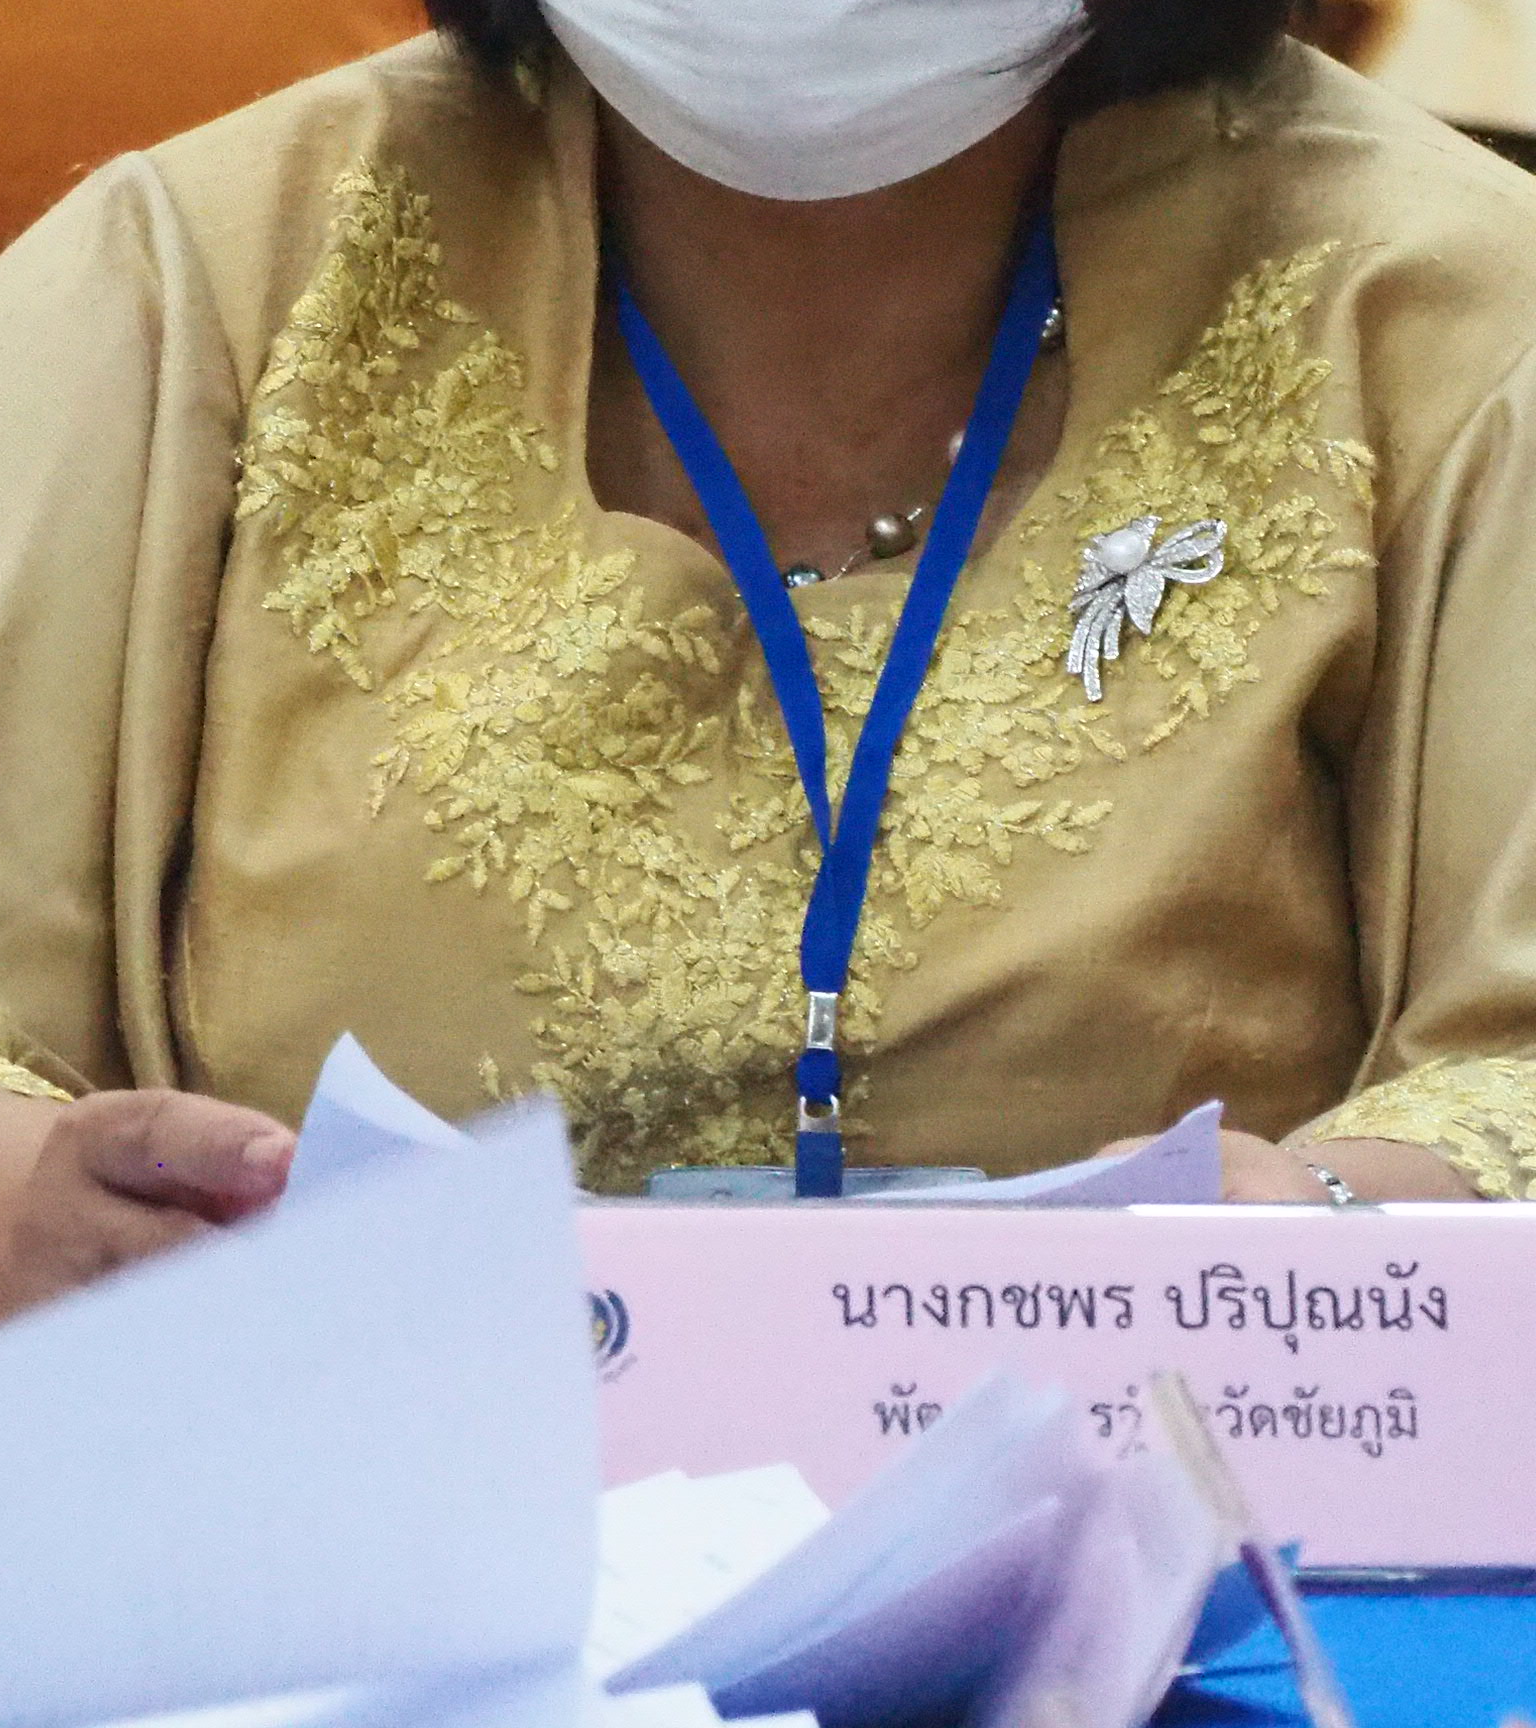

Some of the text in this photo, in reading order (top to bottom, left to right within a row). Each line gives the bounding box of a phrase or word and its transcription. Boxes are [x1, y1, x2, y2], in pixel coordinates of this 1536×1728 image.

[831, 1260, 1450, 1356] นางกชพร ปริปุณนัง
